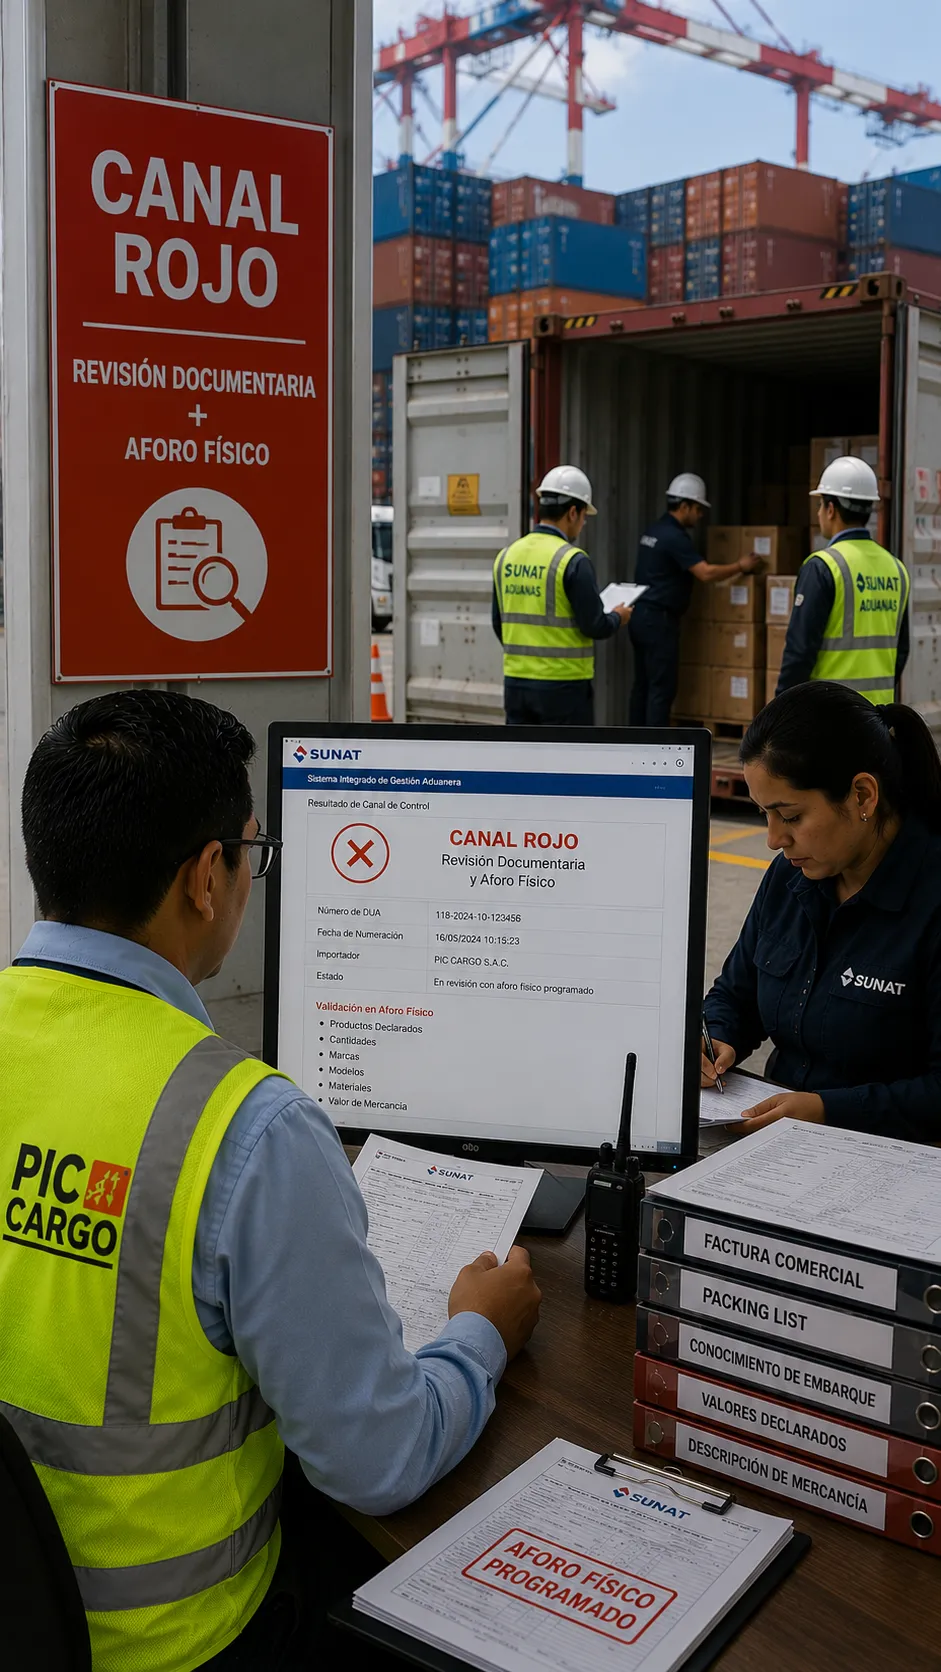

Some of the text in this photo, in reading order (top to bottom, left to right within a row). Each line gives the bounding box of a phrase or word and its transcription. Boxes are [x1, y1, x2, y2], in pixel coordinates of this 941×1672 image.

[91, 149, 299, 236] CANAL
[114, 232, 278, 308] ROJO
[73, 358, 316, 399] REVISIÓN DOCUMENTARIA
[124, 436, 270, 466] AFORO FÍSICO
[504, 563, 546, 579] SUNAT
[505, 584, 541, 597] ADUANAS
[866, 577, 899, 592] SUNAT
[860, 599, 897, 612] ADUANAS
[310, 749, 362, 761] SUNAT
[307, 774, 462, 787] Sistema Integrado de Gestión Aduanera
[308, 799, 430, 811] Resultado de Canal de Control
[450, 829, 579, 850] CANAL ROJO
[441, 853, 586, 871] Revisión Documentaria
[470, 873, 556, 889] y Aforo Físico
[318, 906, 381, 917] Número de DUA
[436, 911, 522, 923] 118-2024-10-123456
[317, 928, 404, 940] Fecha de Numeración
[435, 933, 520, 945] 16/05/2024 10:15:23
[316, 950, 360, 960] Importador
[434, 955, 509, 968] PIC CARGO S.A.C.
[316, 971, 344, 981] Estado
[433, 978, 444, 987] En
[446, 979, 477, 989] revisión
[479, 981, 494, 989] con
[496, 980, 518, 990] aforo
[543, 984, 594, 995] programado
[854, 974, 906, 995] SUNAT
[316, 1002, 434, 1017] Validación en Aforo Físico
[330, 1020, 423, 1034] Productos Declarados
[329, 1035, 377, 1046] Cantidades
[329, 1051, 360, 1061] Marcas
[329, 1066, 365, 1077] Modelos
[328, 1081, 372, 1092] Materiales
[328, 1096, 350, 1106] Valor
[351, 1098, 362, 1107] de
[11, 1143, 86, 1204] PIC
[438, 1168, 474, 1182] SUNAT
[6, 1197, 117, 1256] CARGO
[704, 1232, 864, 1290] FACTURA COMERCIAL
[703, 1286, 808, 1332] PACKING LIST
[690, 1338, 876, 1408] CONOCIMIENTO DE EMBARQUE
[701, 1391, 847, 1452] VALORES DECLARADOS
[688, 1438, 868, 1514] DESCRIPCIÓN DE MERCANCÍA
[629, 1492, 691, 1520] SUNAT
[504, 1540, 655, 1610] AFORO FÍSICO
[481, 1557, 637, 1631] PROGRAMADO
